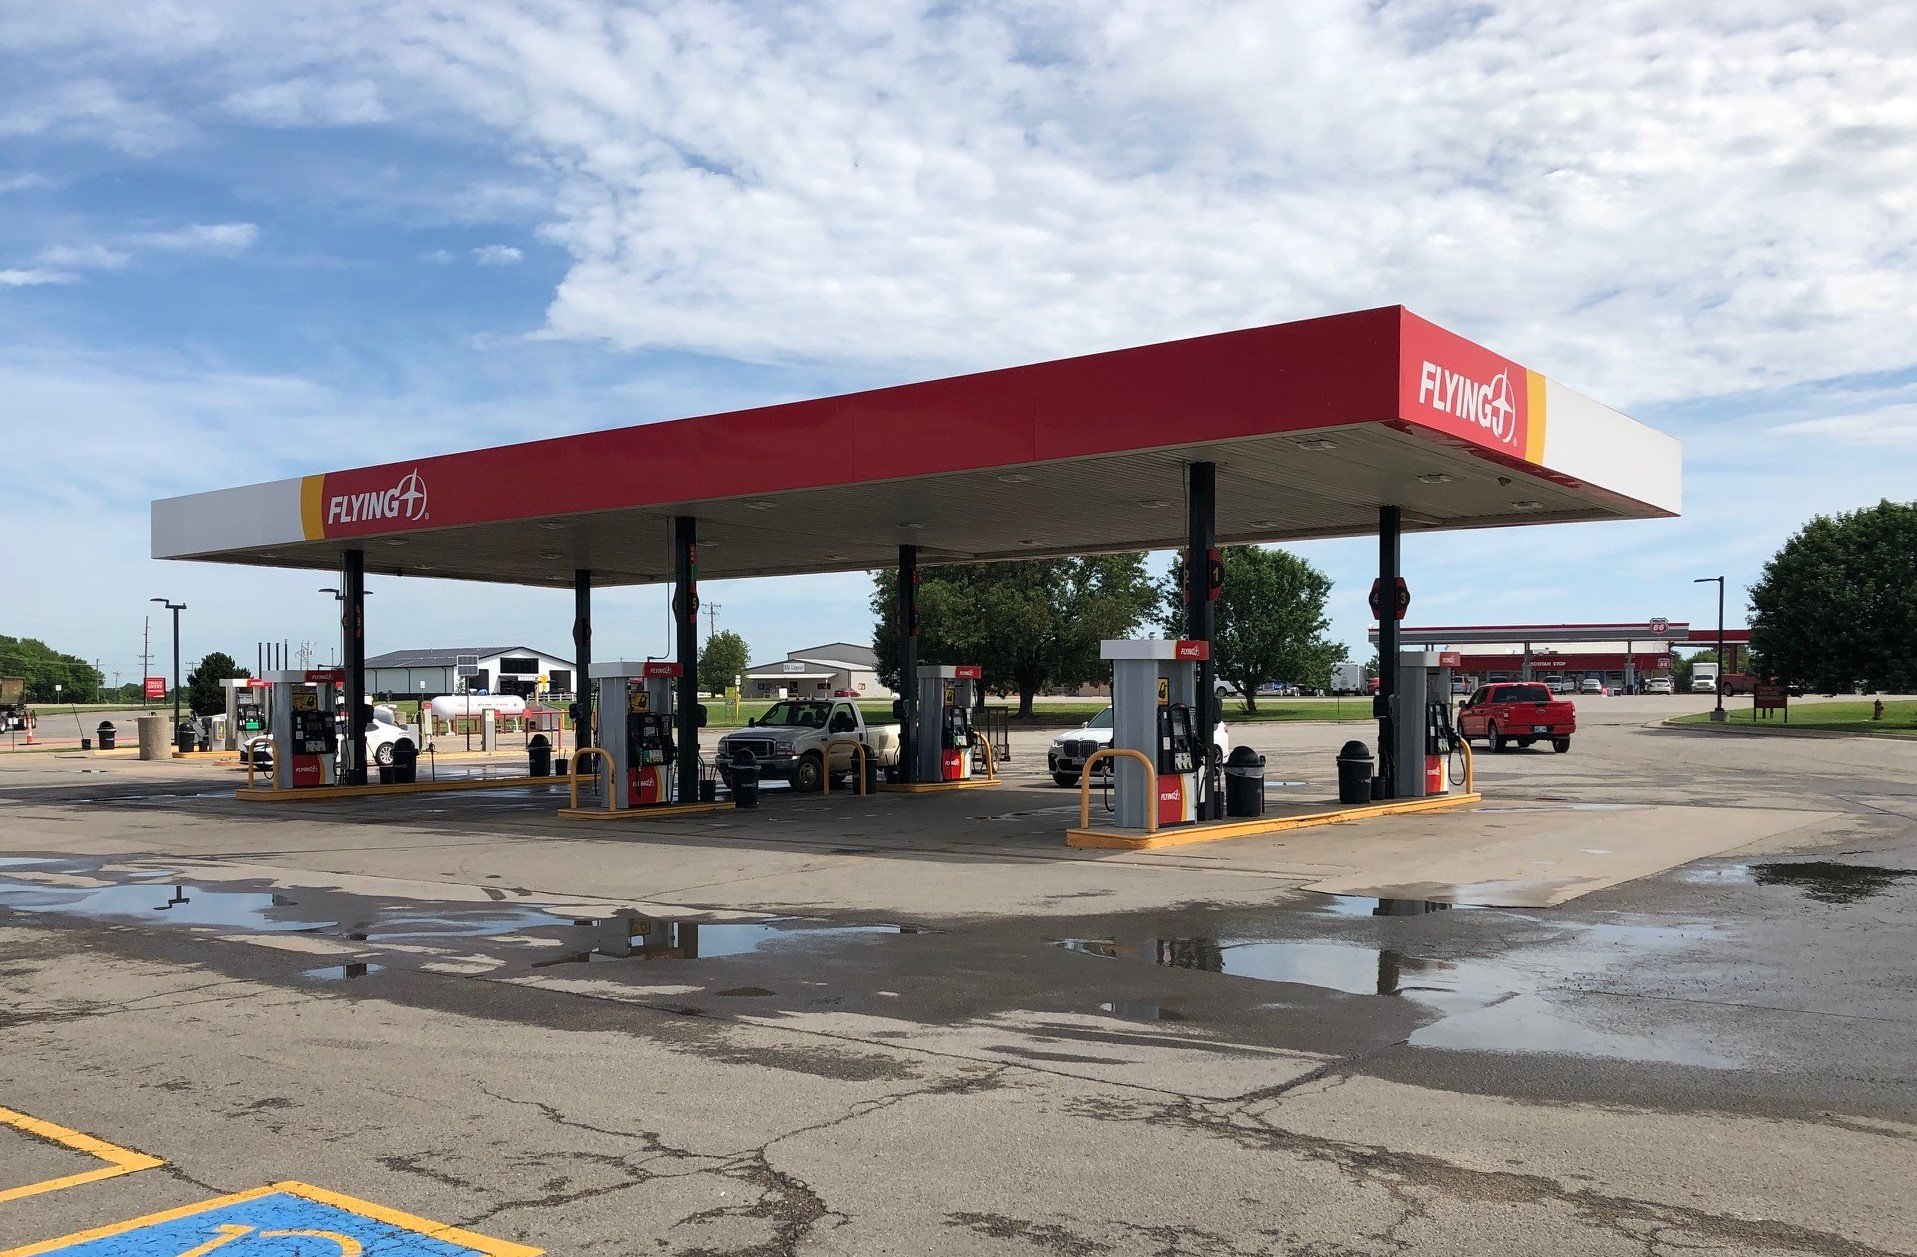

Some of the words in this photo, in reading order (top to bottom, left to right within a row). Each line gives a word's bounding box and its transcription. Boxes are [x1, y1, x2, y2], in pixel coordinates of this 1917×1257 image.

[1213, 566, 1219, 582] 1
[692, 597, 698, 609] 5
[1400, 592, 1407, 605] 3
[1652, 623, 1665, 631] 66
